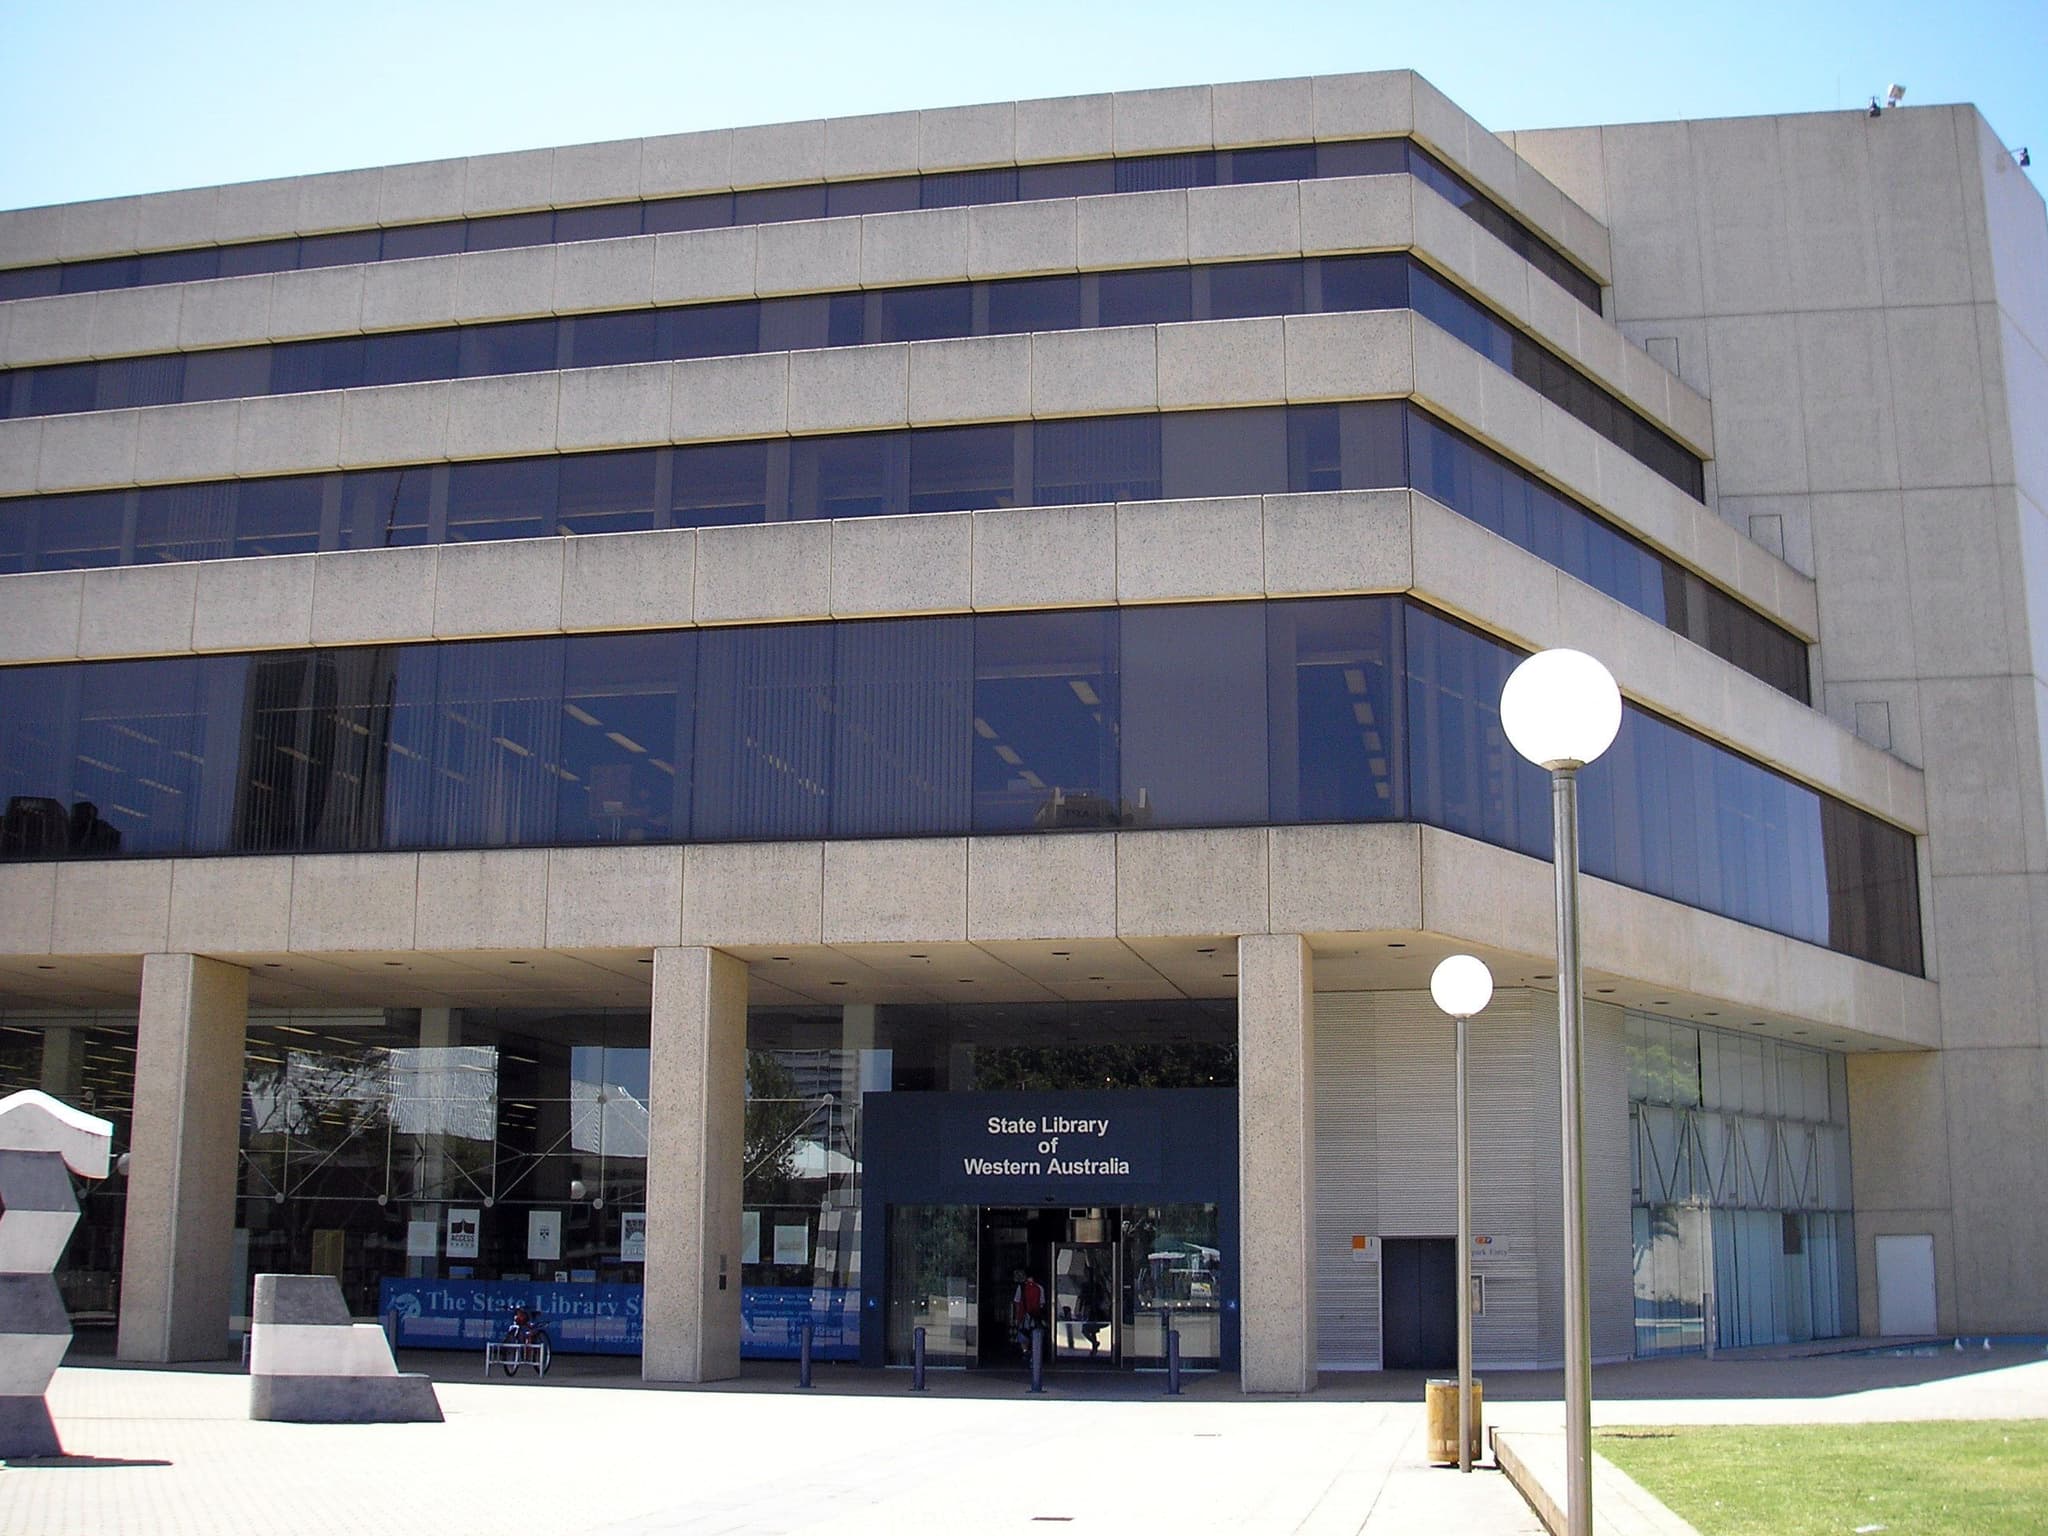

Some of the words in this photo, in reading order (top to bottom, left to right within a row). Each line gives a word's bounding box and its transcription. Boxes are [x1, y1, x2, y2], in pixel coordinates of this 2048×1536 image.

[987, 1117, 1037, 1134] State
[1041, 1116, 1109, 1137] Library
[1037, 1137, 1060, 1154] of
[963, 1158, 1041, 1175] Western
[1047, 1158, 1130, 1175] Australia
[426, 1290, 466, 1311] The
[473, 1292, 526, 1312] State
[536, 1292, 619, 1316] Library
[625, 1296, 643, 1316] S
